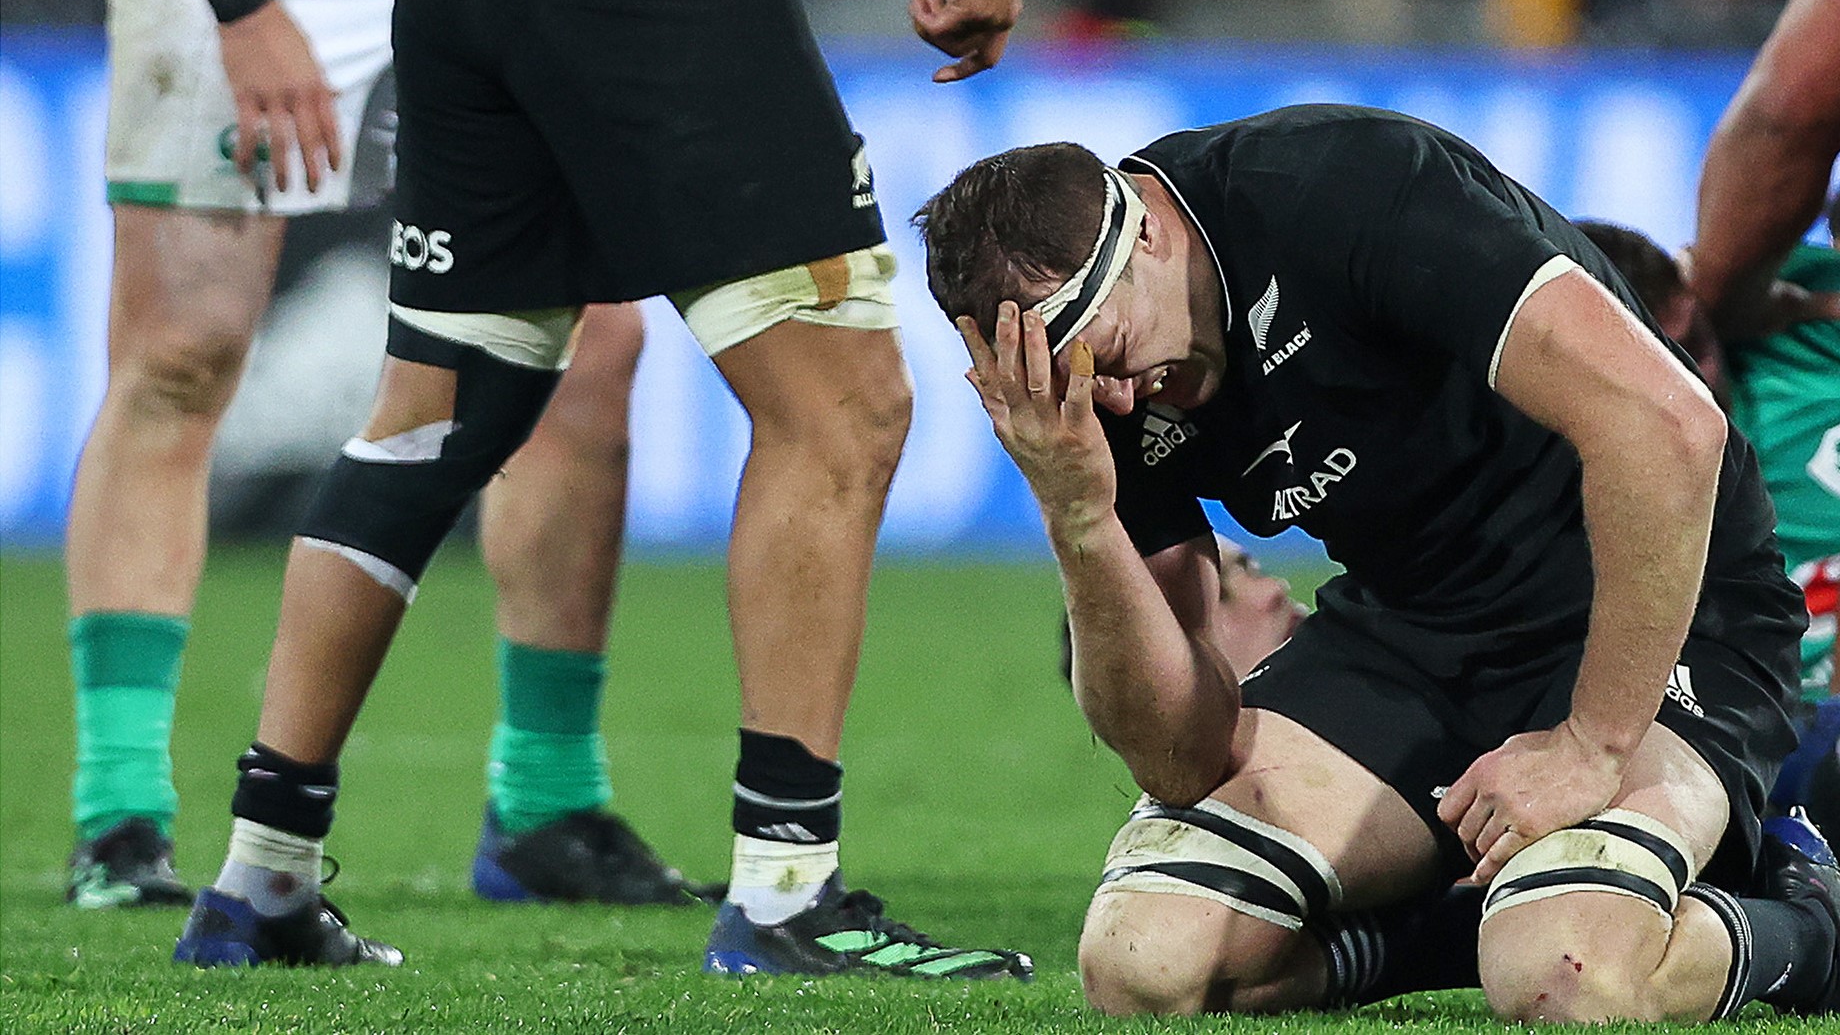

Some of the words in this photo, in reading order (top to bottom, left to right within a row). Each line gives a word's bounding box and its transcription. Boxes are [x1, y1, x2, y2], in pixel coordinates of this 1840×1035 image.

[389, 217, 455, 275] EOS
[1271, 326, 1312, 365] BLACK
[1271, 447, 1357, 521] ALTRAD
[1665, 687, 1705, 719] das
